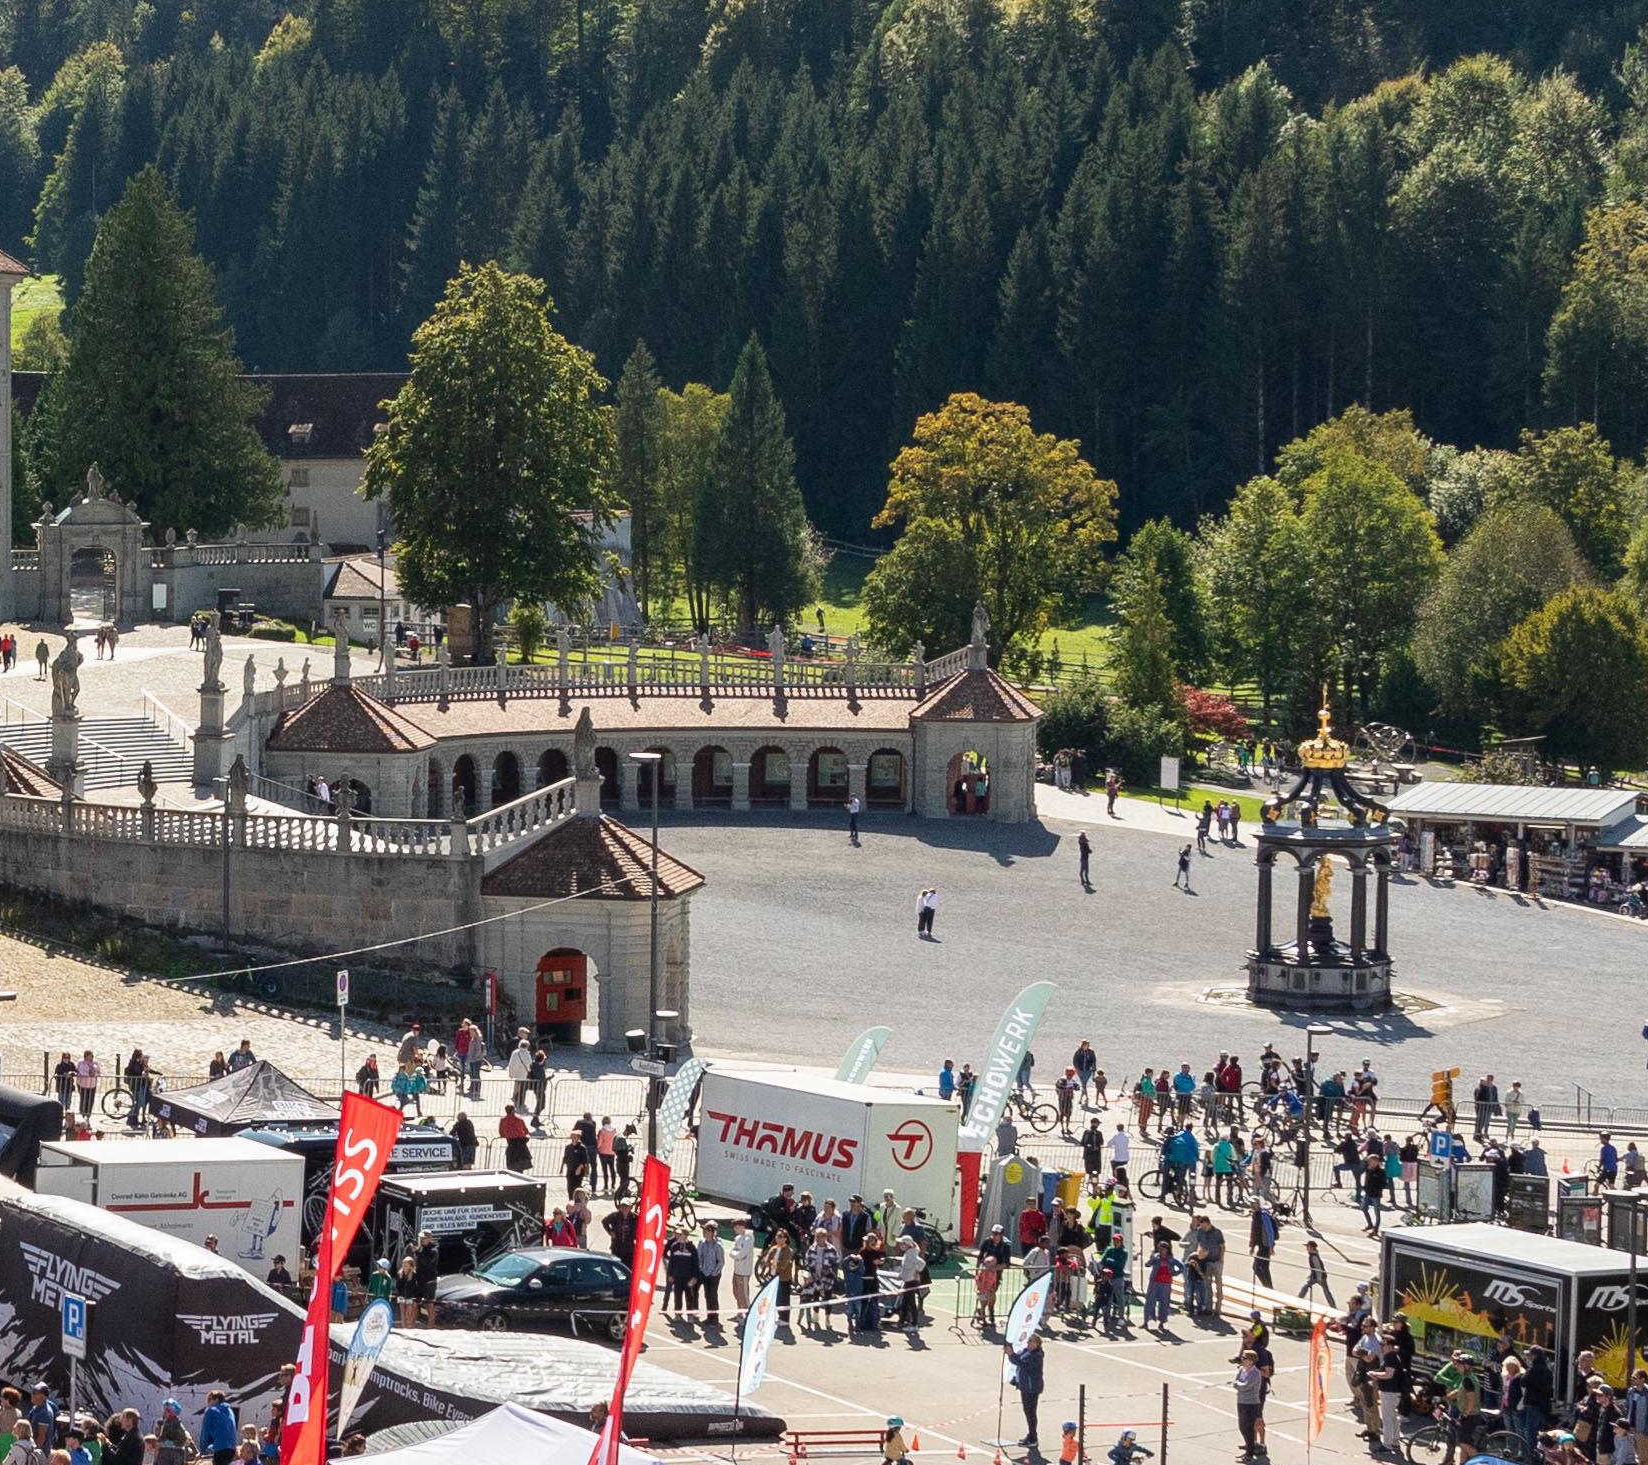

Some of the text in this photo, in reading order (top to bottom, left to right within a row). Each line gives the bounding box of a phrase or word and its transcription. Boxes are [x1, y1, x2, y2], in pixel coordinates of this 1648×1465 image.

[1437, 1137, 1447, 1152] P
[724, 1150, 842, 1184] SWISS MADE TO FASCINATE
[111, 1193, 130, 1201] Conrad
[444, 1207, 456, 1216] UNS
[31, 1273, 67, 1311] MET
[68, 1303, 80, 1329] P
[200, 1330, 259, 1344] METAL
[370, 1368, 445, 1414] mptracks. Bike
